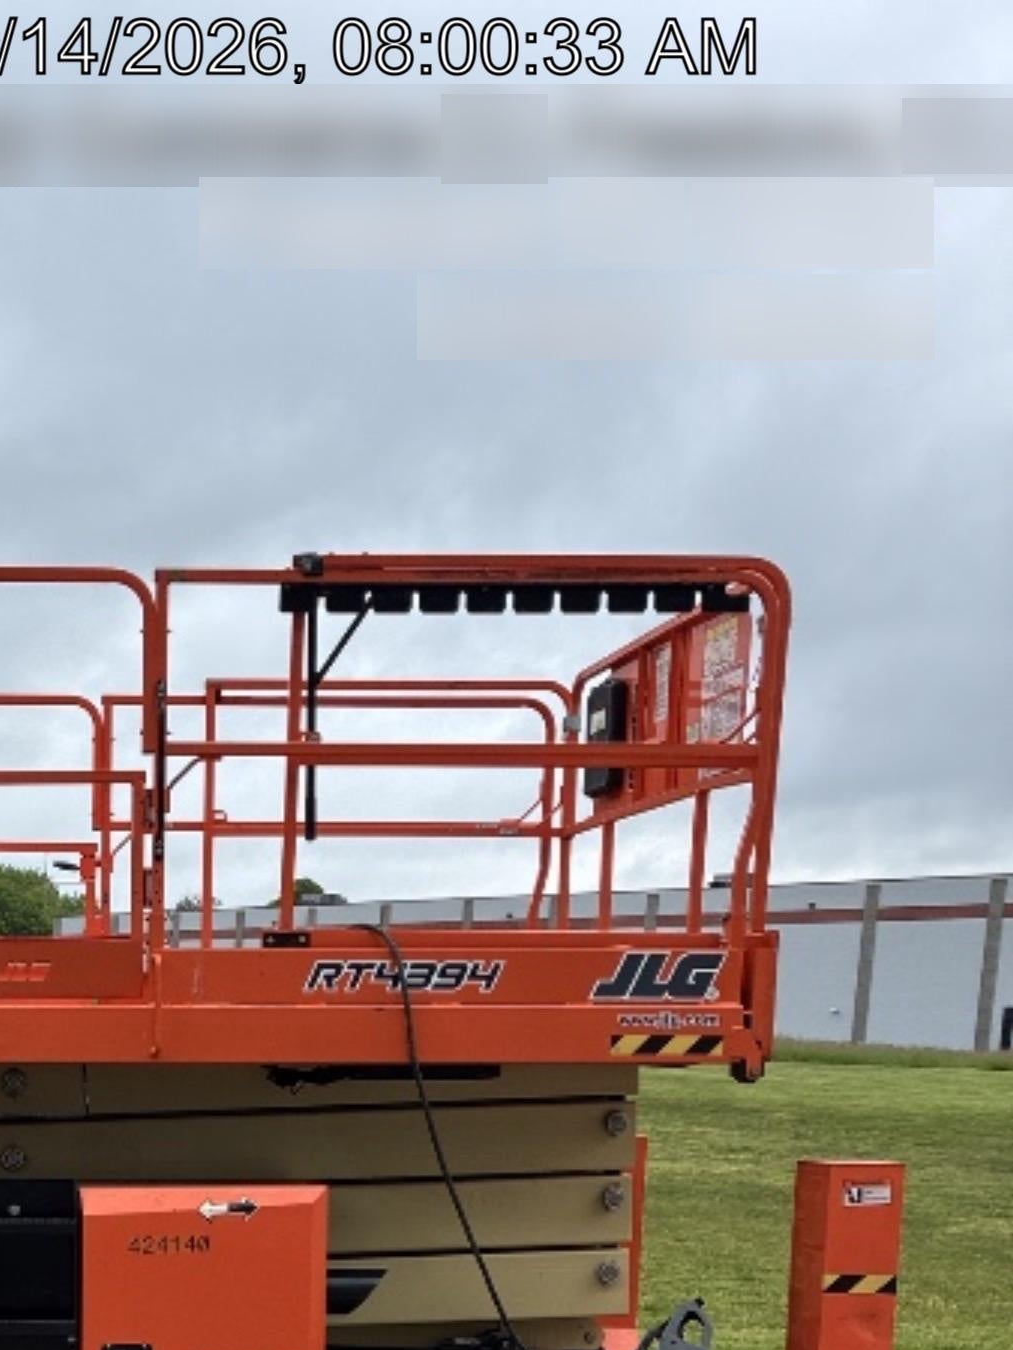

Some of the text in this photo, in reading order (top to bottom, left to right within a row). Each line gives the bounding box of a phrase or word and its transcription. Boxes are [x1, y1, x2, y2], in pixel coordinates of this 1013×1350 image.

[302, 959, 507, 994] RT4394
[588, 950, 728, 1002] JLG
[127, 1234, 211, 1255] 424140
